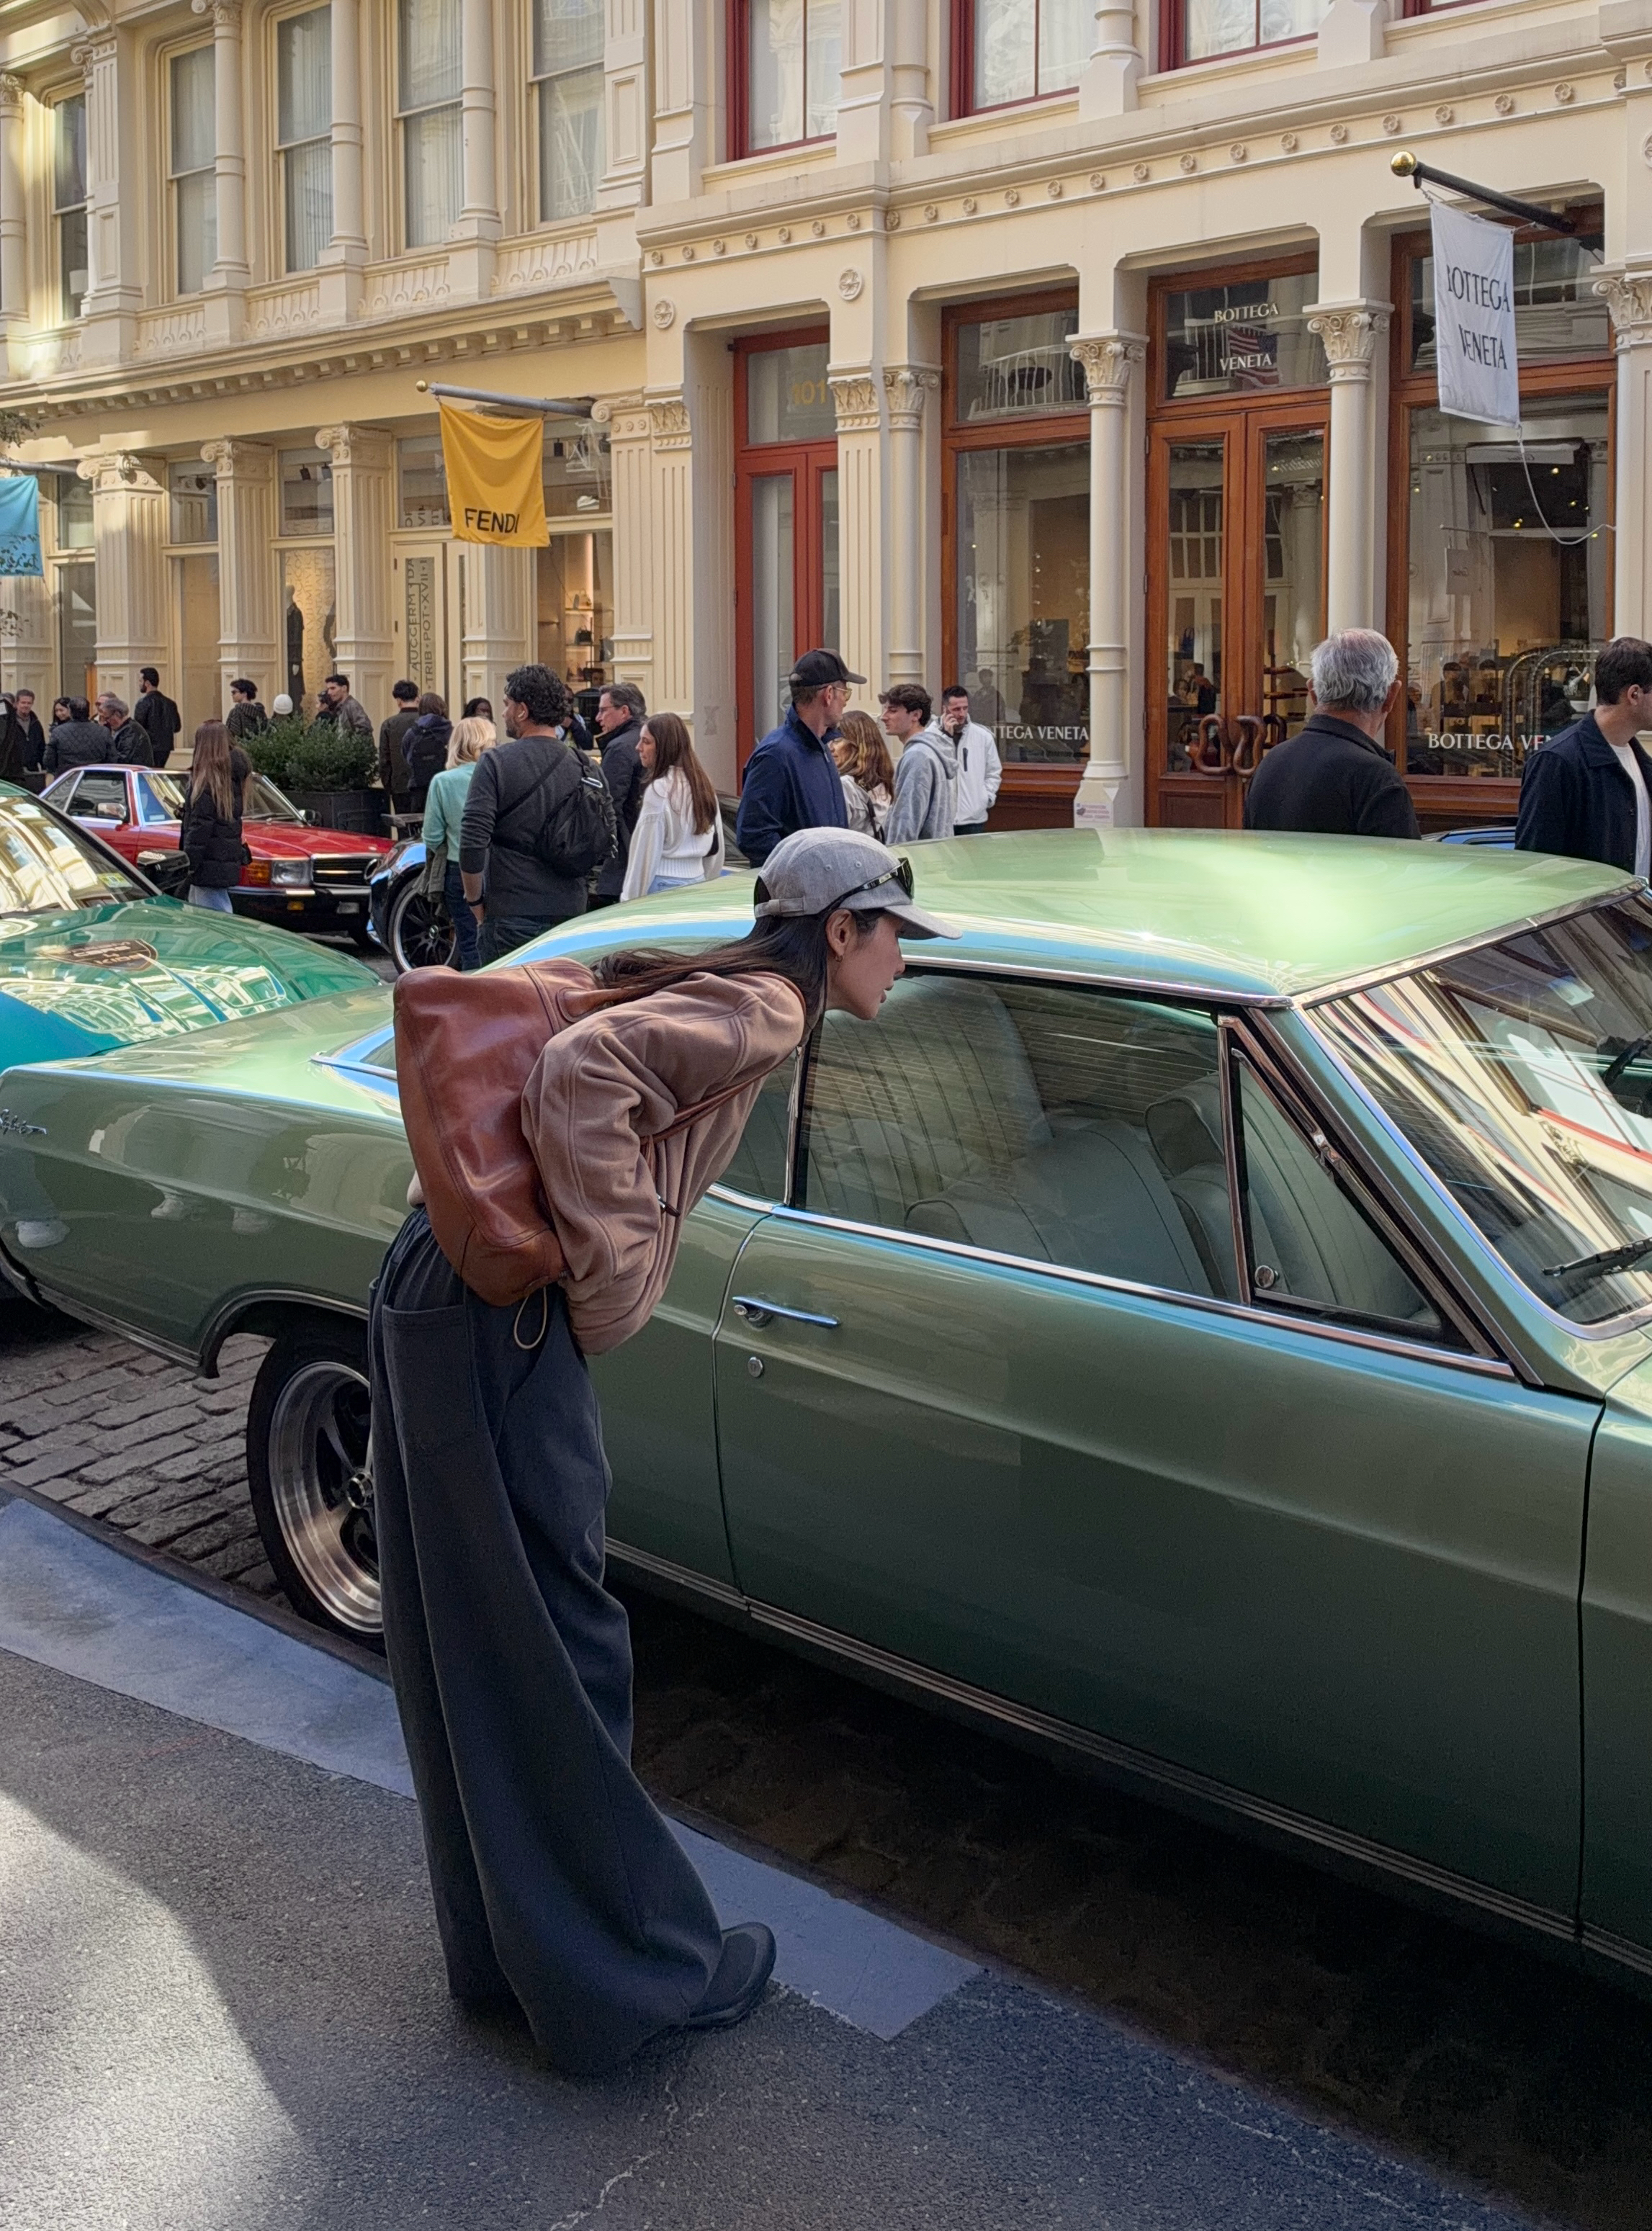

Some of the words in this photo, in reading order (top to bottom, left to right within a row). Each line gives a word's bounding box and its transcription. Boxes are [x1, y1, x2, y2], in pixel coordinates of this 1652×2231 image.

[1214, 302, 1278, 323] BOTTEGA
[1220, 353, 1272, 371] VENETA
[791, 379, 826, 406] 101
[464, 508, 520, 534] FENDI
[992, 725, 1033, 740] TTEGA
[1037, 726, 1089, 740] VENETA
[1428, 733, 1514, 750] BOTTEGA
